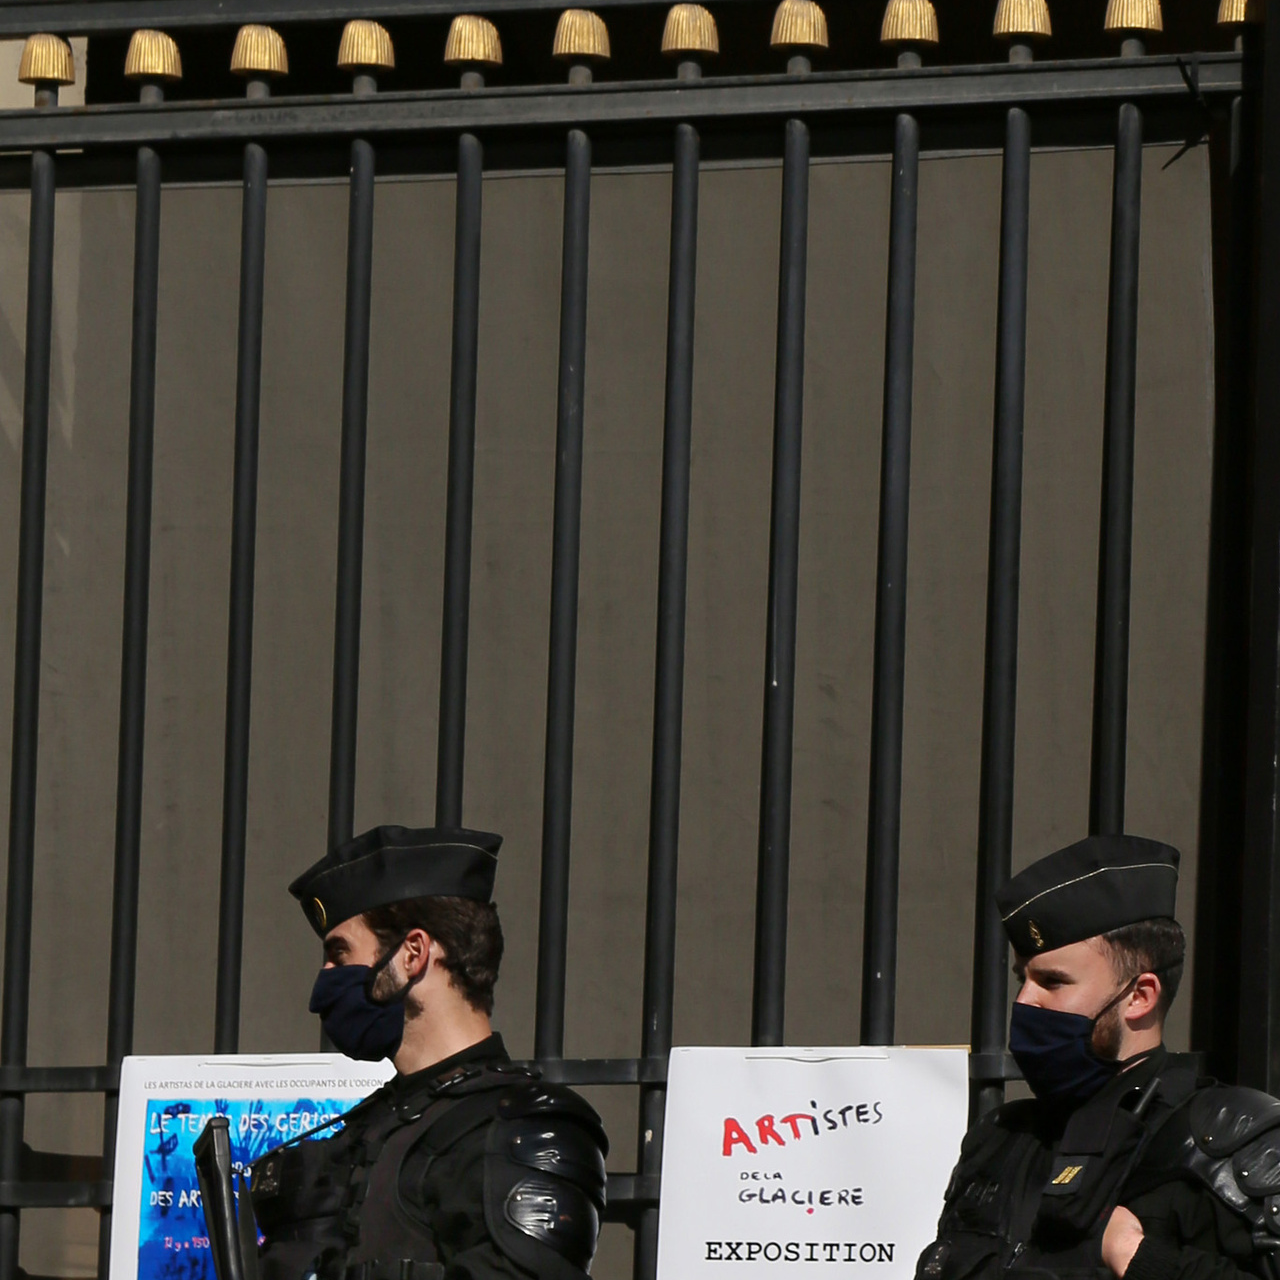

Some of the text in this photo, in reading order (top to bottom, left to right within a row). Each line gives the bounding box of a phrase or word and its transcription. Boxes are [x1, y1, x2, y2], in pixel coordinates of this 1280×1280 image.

[144, 1081, 156, 1089] LES
[276, 1080, 288, 1088] LES
[151, 1112, 172, 1134] LE
[239, 1114, 269, 1133] DES
[150, 1191, 173, 1206] DES
[705, 1242, 895, 1262] EXPOSITION
